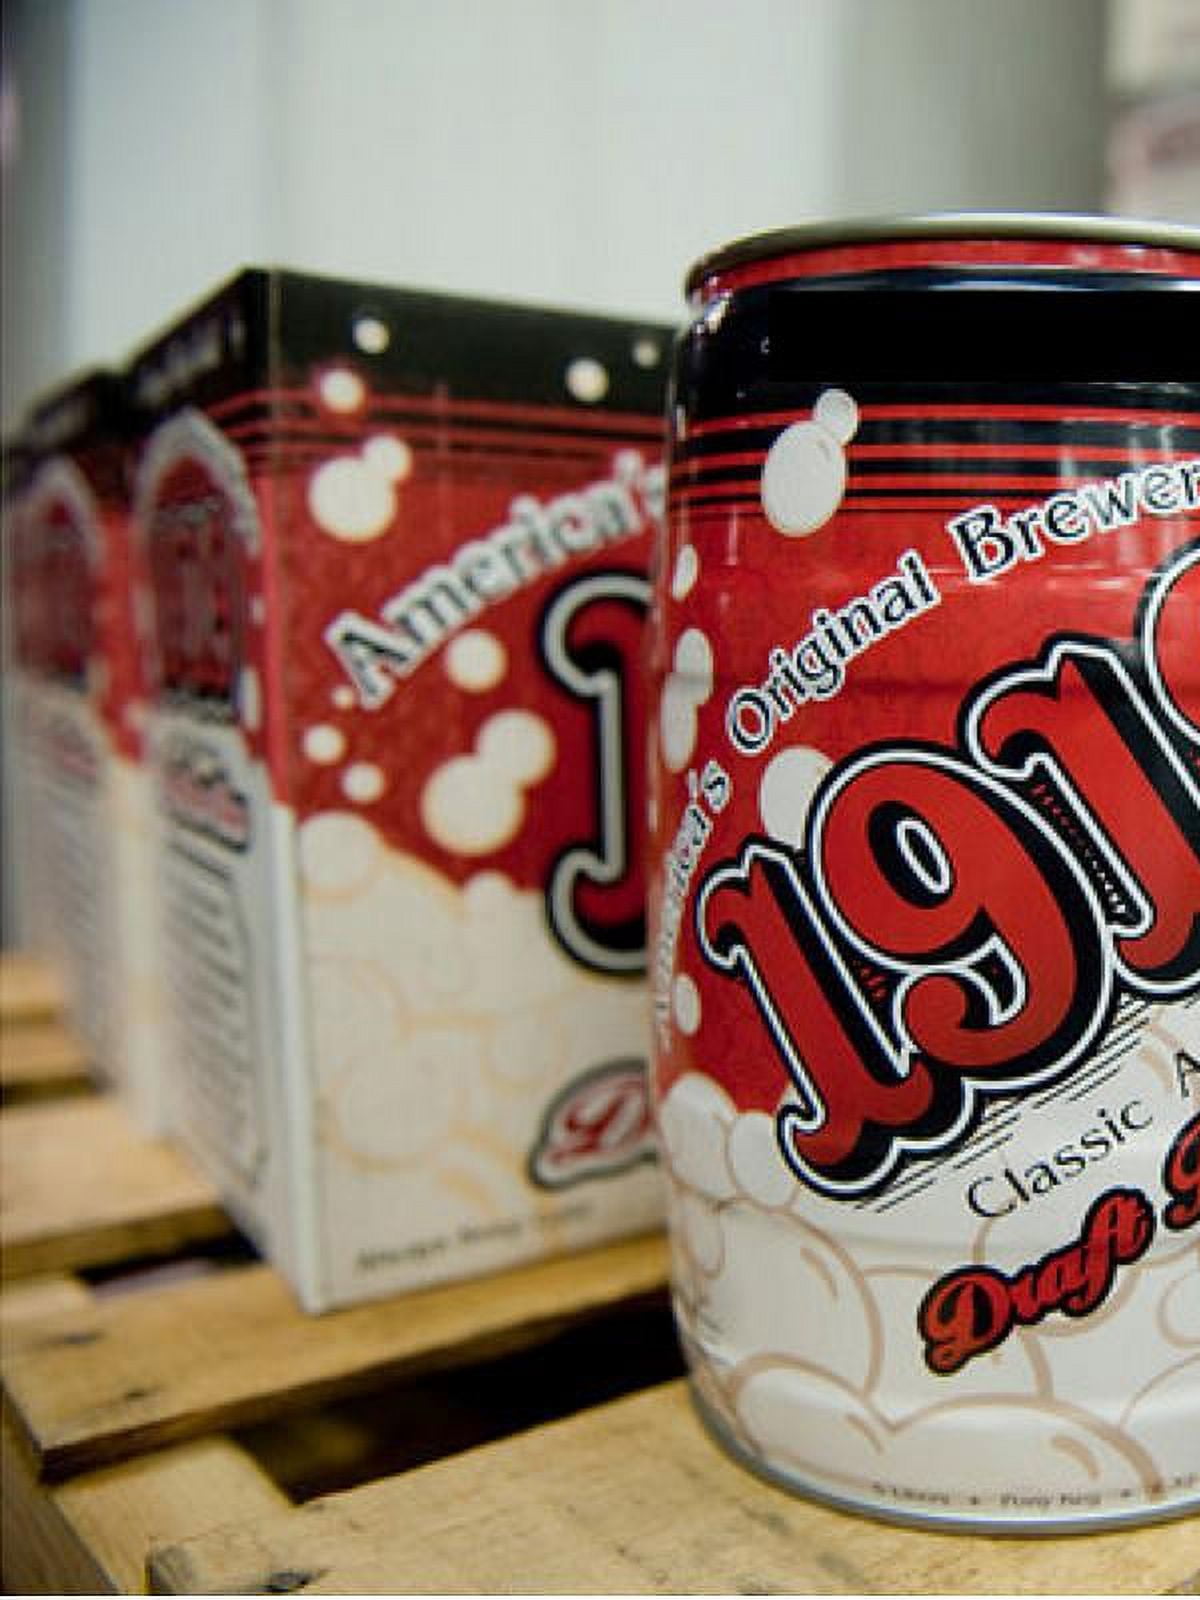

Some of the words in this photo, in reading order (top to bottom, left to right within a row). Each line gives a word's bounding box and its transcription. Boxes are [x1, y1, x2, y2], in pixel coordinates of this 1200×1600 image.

[728, 550, 941, 754] Original
[965, 1098, 1154, 1218] Classic
[917, 1188, 1156, 1375] Draft
